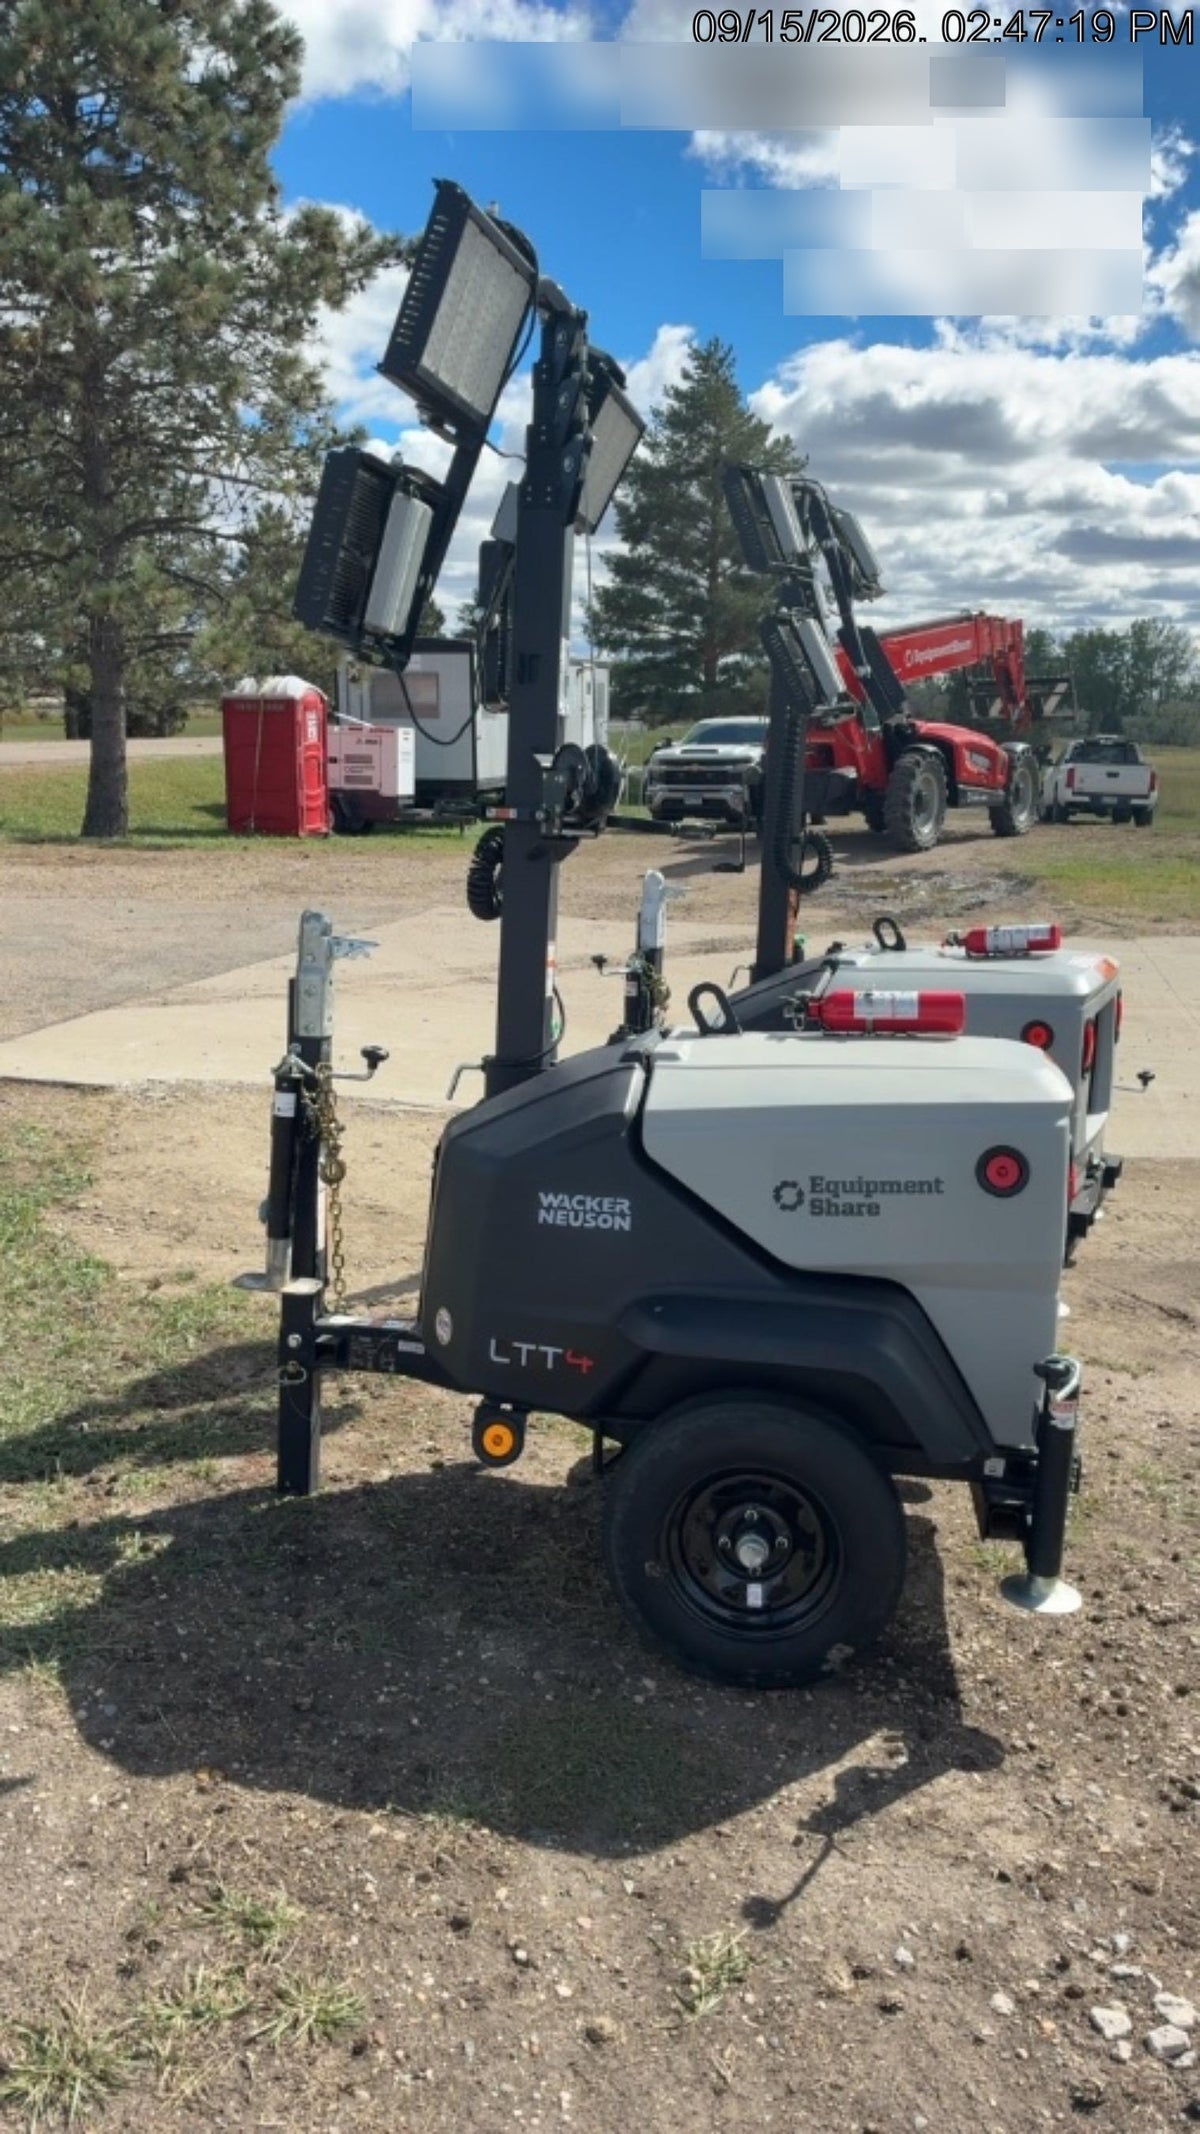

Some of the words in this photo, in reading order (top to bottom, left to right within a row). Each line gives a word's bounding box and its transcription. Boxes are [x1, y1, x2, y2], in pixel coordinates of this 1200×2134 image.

[809, 1175, 945, 1198] Equipment
[538, 1192, 632, 1215] WACKER
[809, 1197, 881, 1217] Share
[537, 1208, 632, 1231] NEUSON
[490, 1338, 594, 1374] LTT4
